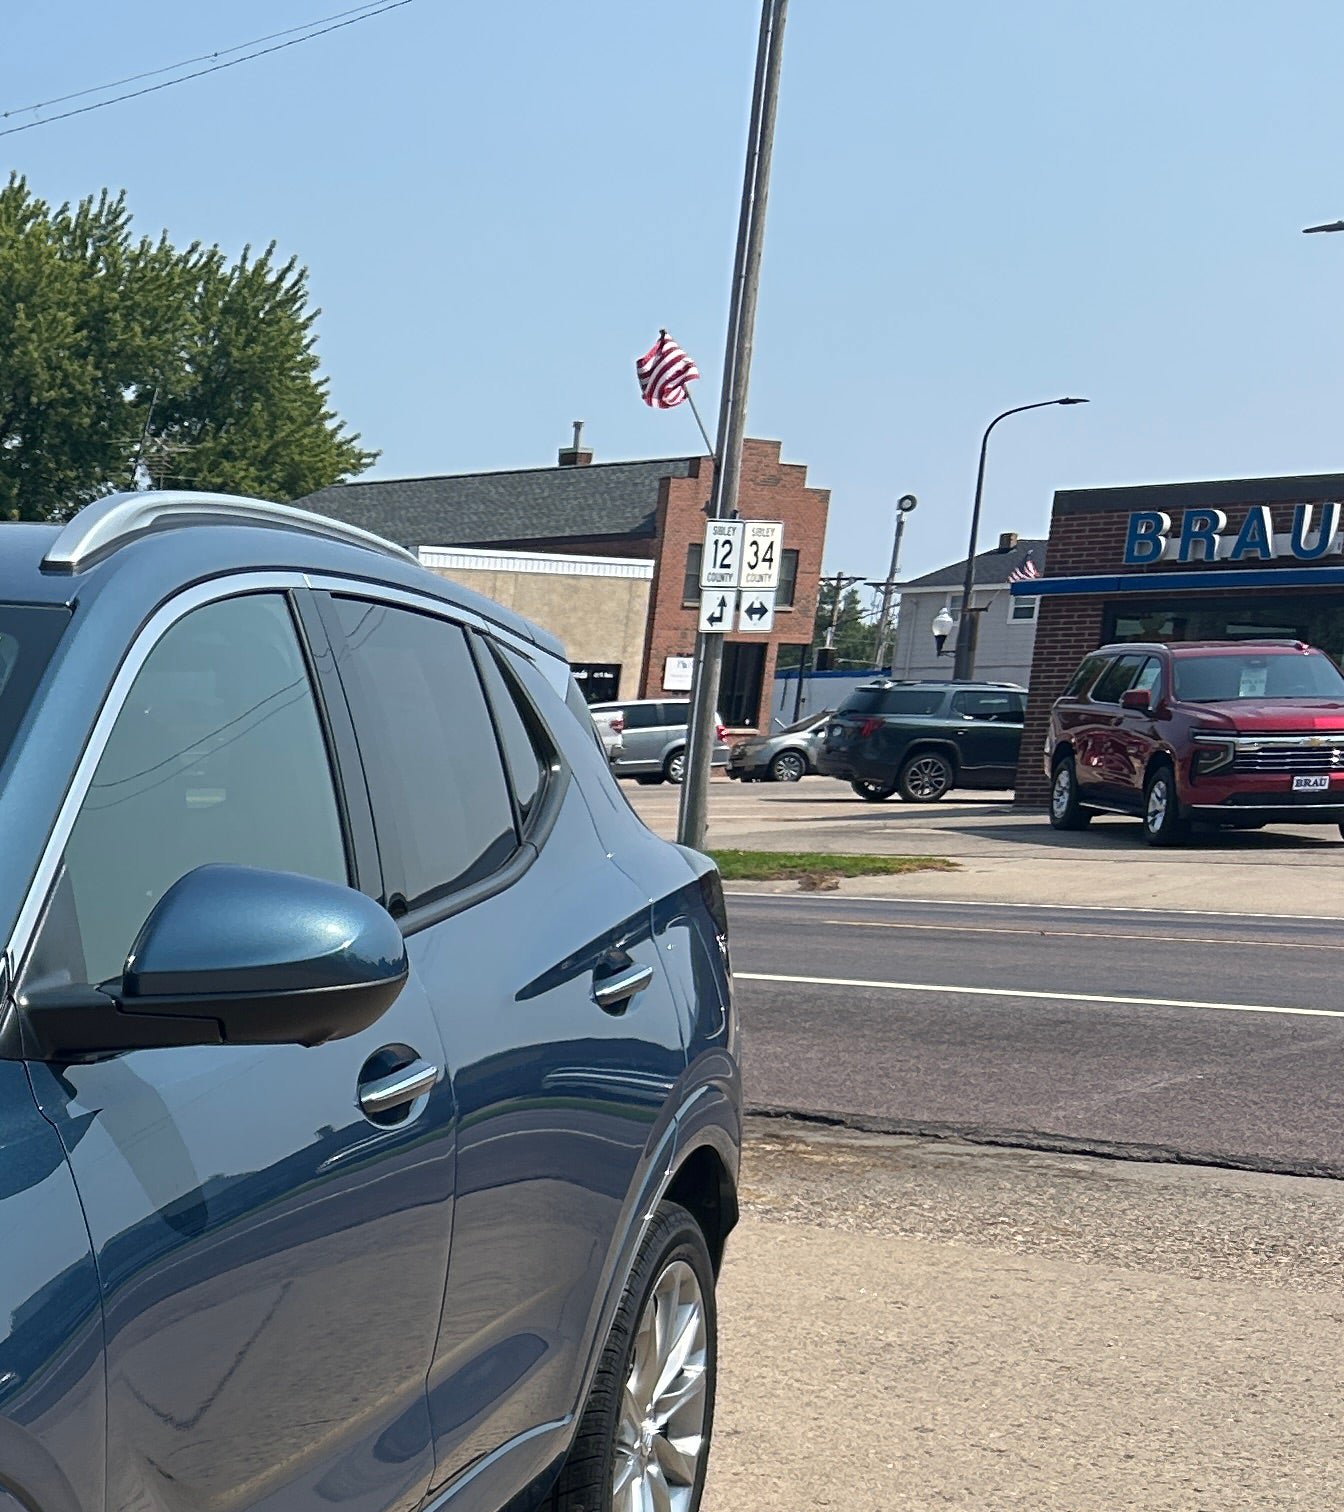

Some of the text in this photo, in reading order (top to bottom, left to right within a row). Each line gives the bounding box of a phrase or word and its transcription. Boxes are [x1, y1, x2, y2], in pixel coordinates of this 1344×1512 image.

[1123, 503, 1339, 564] BRAU
[712, 539, 733, 570] 12
[747, 540, 775, 570] 34
[706, 572, 734, 583] COUNTY
[1294, 777, 1328, 789] BRAU
